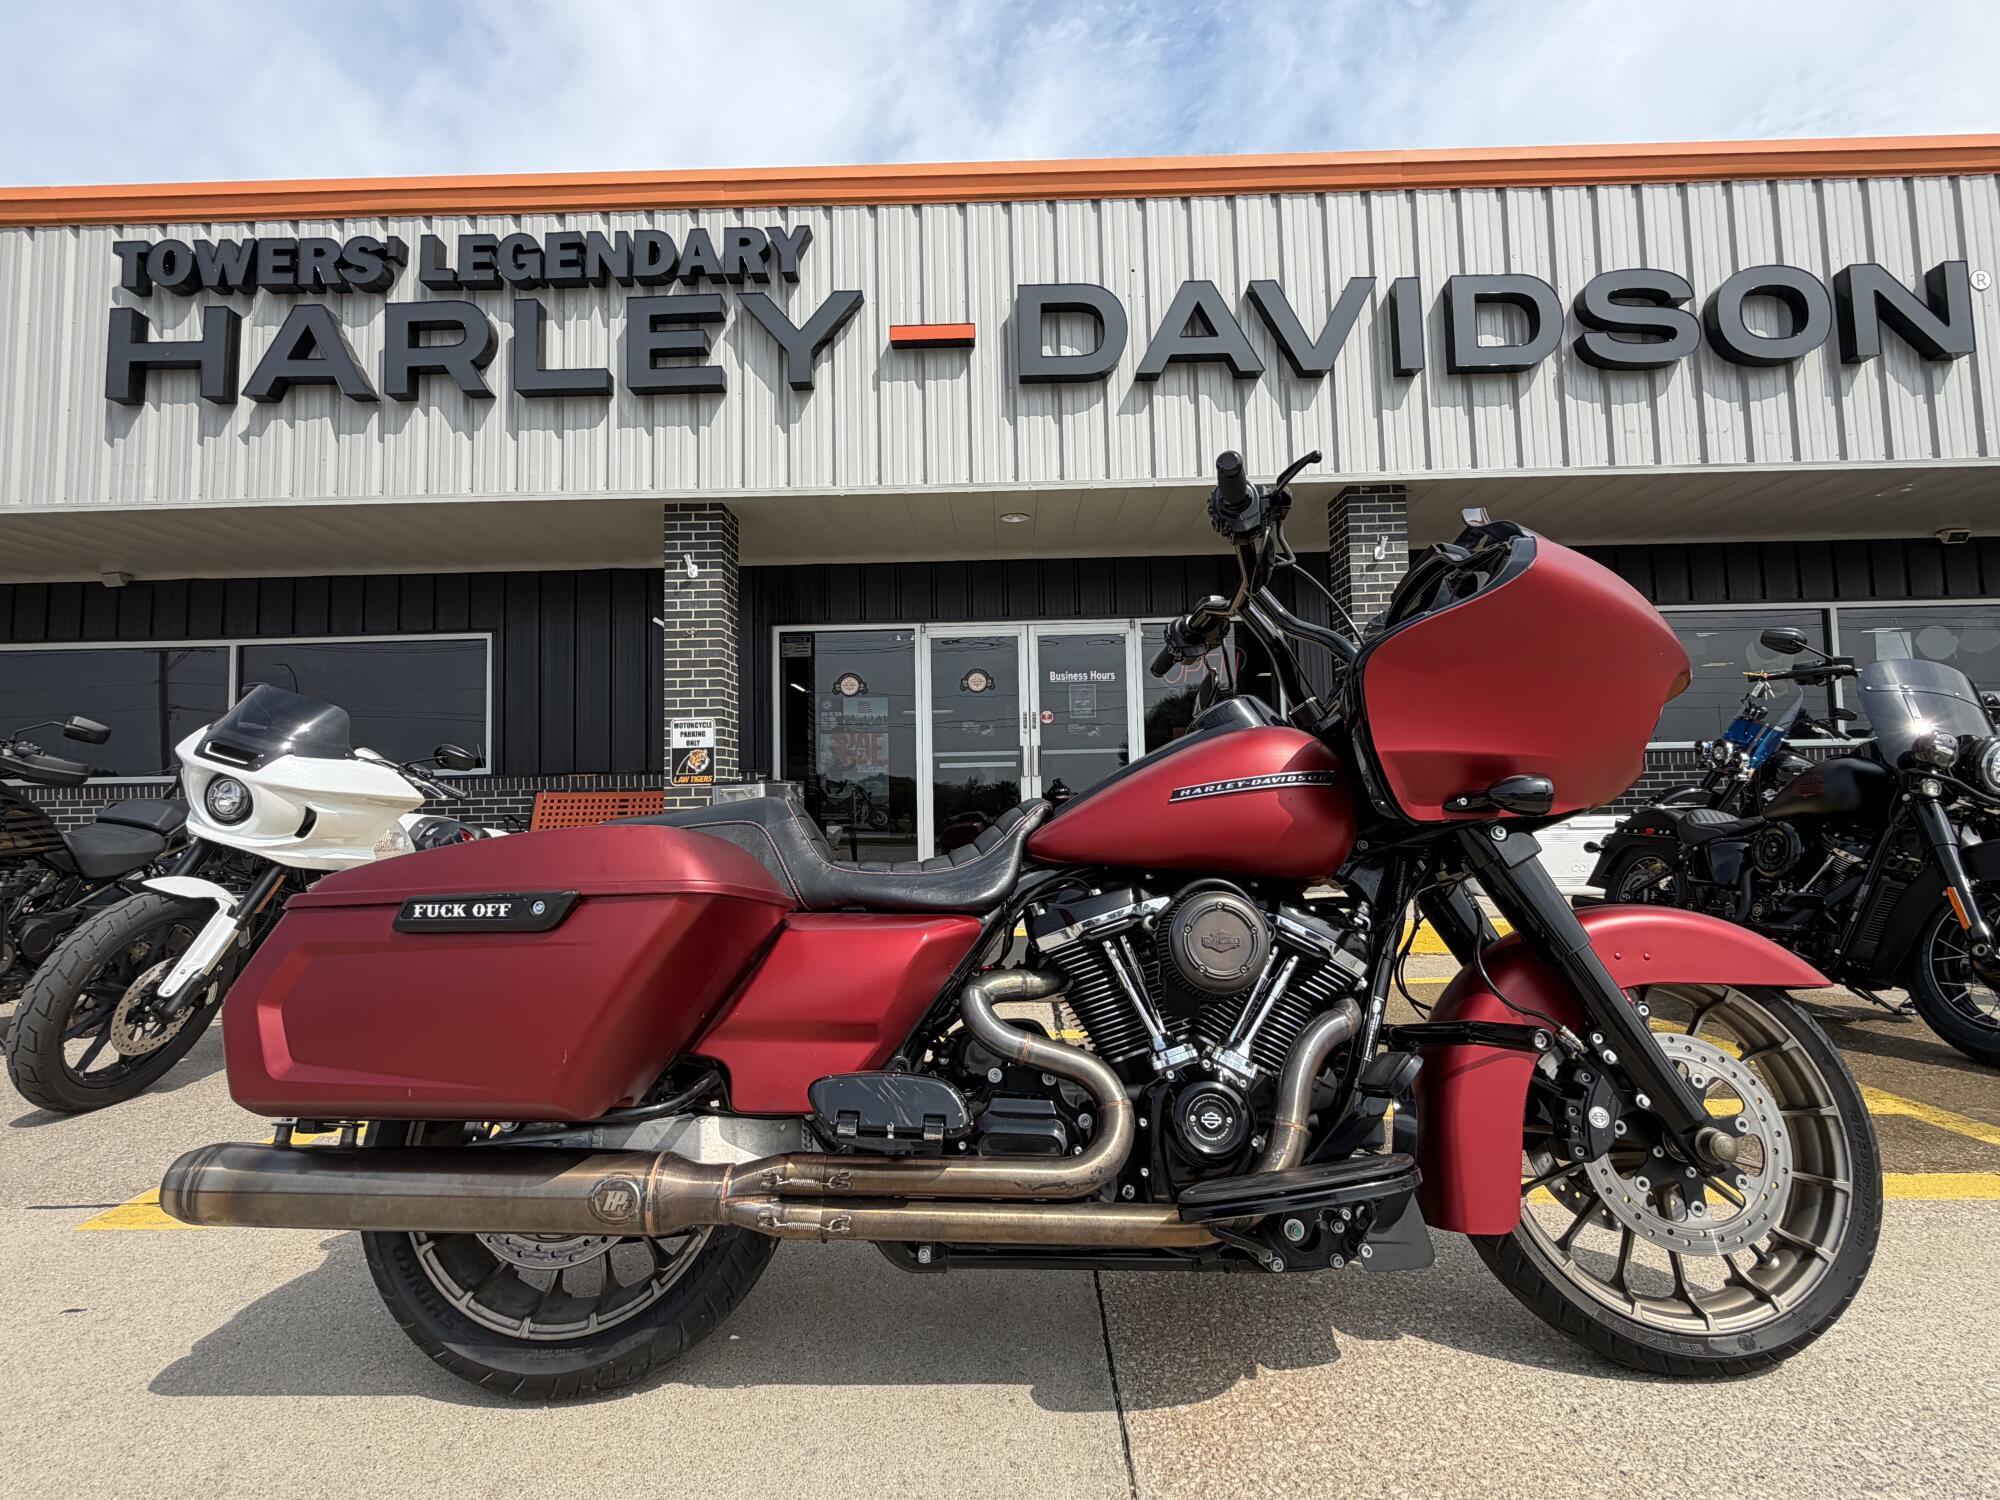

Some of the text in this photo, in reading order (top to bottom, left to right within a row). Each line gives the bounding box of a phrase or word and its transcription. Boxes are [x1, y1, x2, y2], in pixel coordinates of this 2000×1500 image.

[419, 225, 814, 293] LEGENDARY
[105, 290, 865, 406] HARLEY
[1017, 260, 1977, 385] DAVIDSON
[1049, 670, 1116, 682] Business Hours
[673, 721, 713, 729] MOTORCYCLE
[680, 730, 706, 738] PARKING
[673, 774, 713, 784] LAW TIGERS
[1179, 774, 1328, 797] HARLEY-DAVIDSON
[412, 903, 512, 918] FUCK OFF
